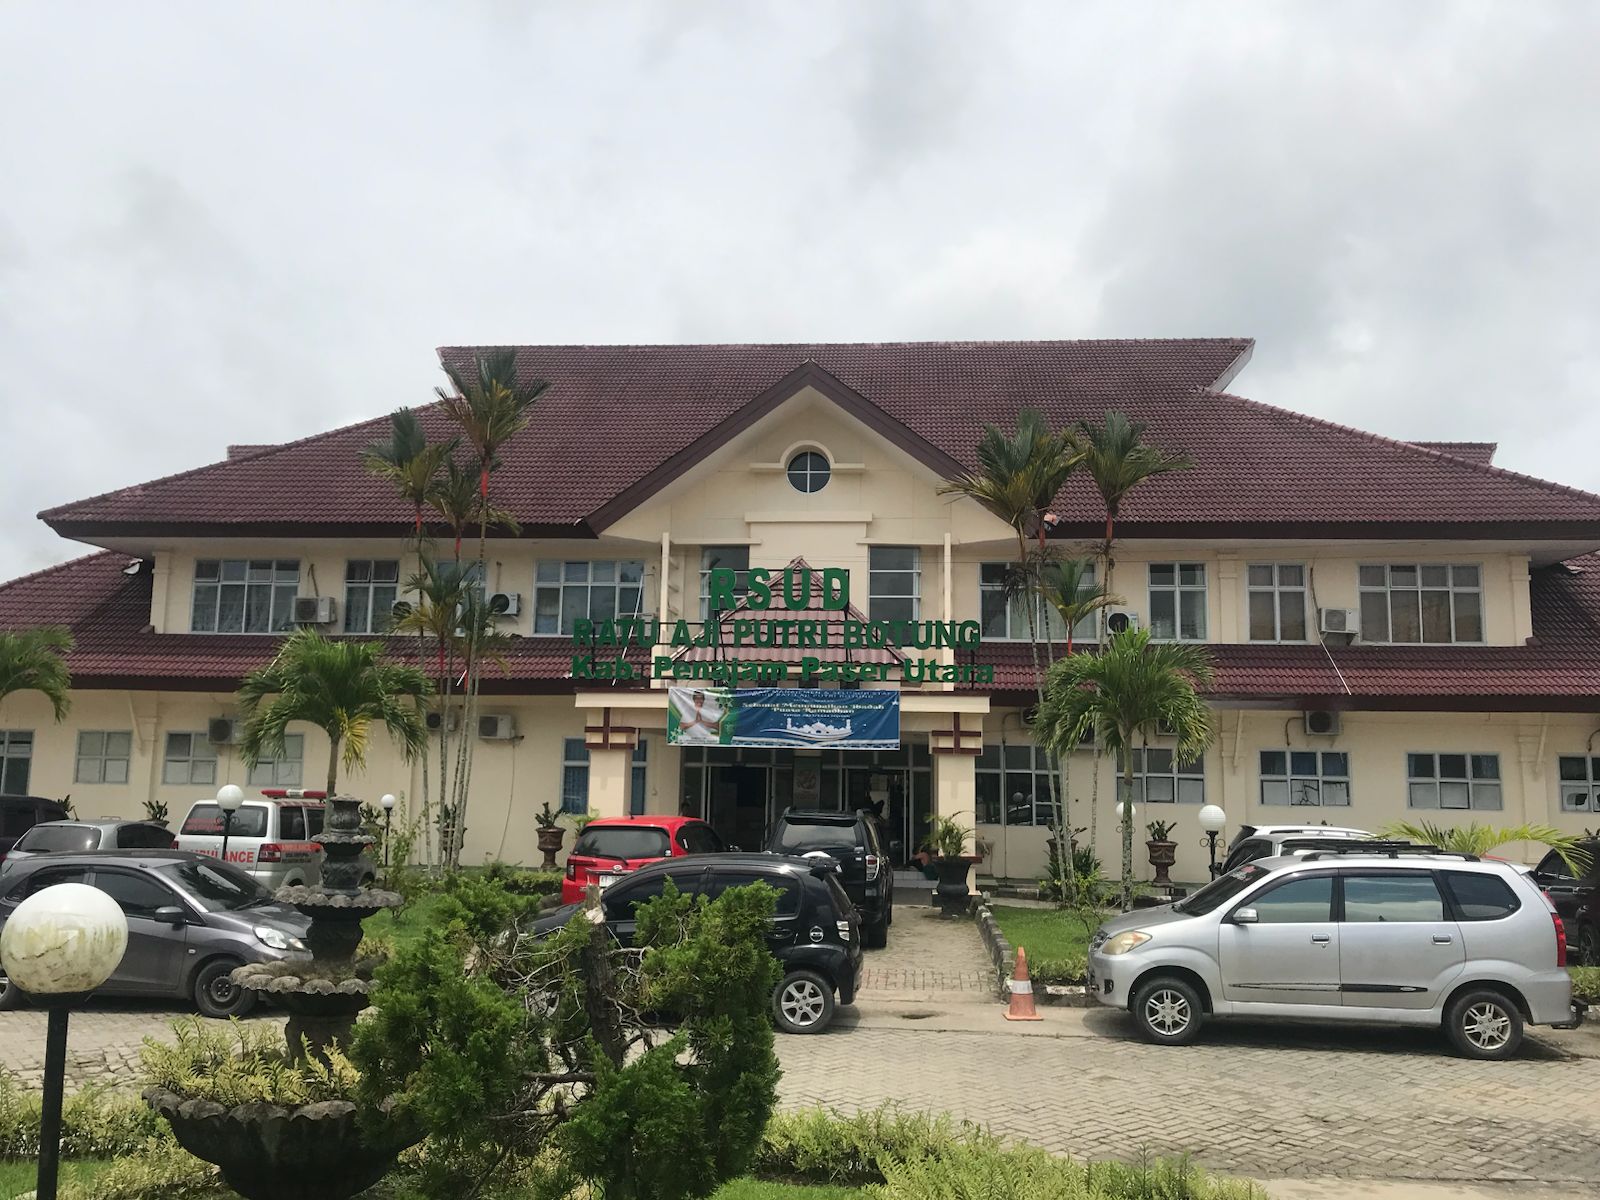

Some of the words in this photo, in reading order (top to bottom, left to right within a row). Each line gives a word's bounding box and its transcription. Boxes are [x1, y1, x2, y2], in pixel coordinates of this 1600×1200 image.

[711, 567, 850, 611] RSUD
[573, 618, 659, 648] RATU
[670, 619, 719, 648] AJI
[733, 620, 829, 649] PUTRI
[843, 620, 981, 650] BOTUNG
[572, 655, 641, 680] Kab.
[654, 656, 788, 687] Penajam
[801, 656, 892, 682] Paser
[904, 658, 994, 684] Utara
